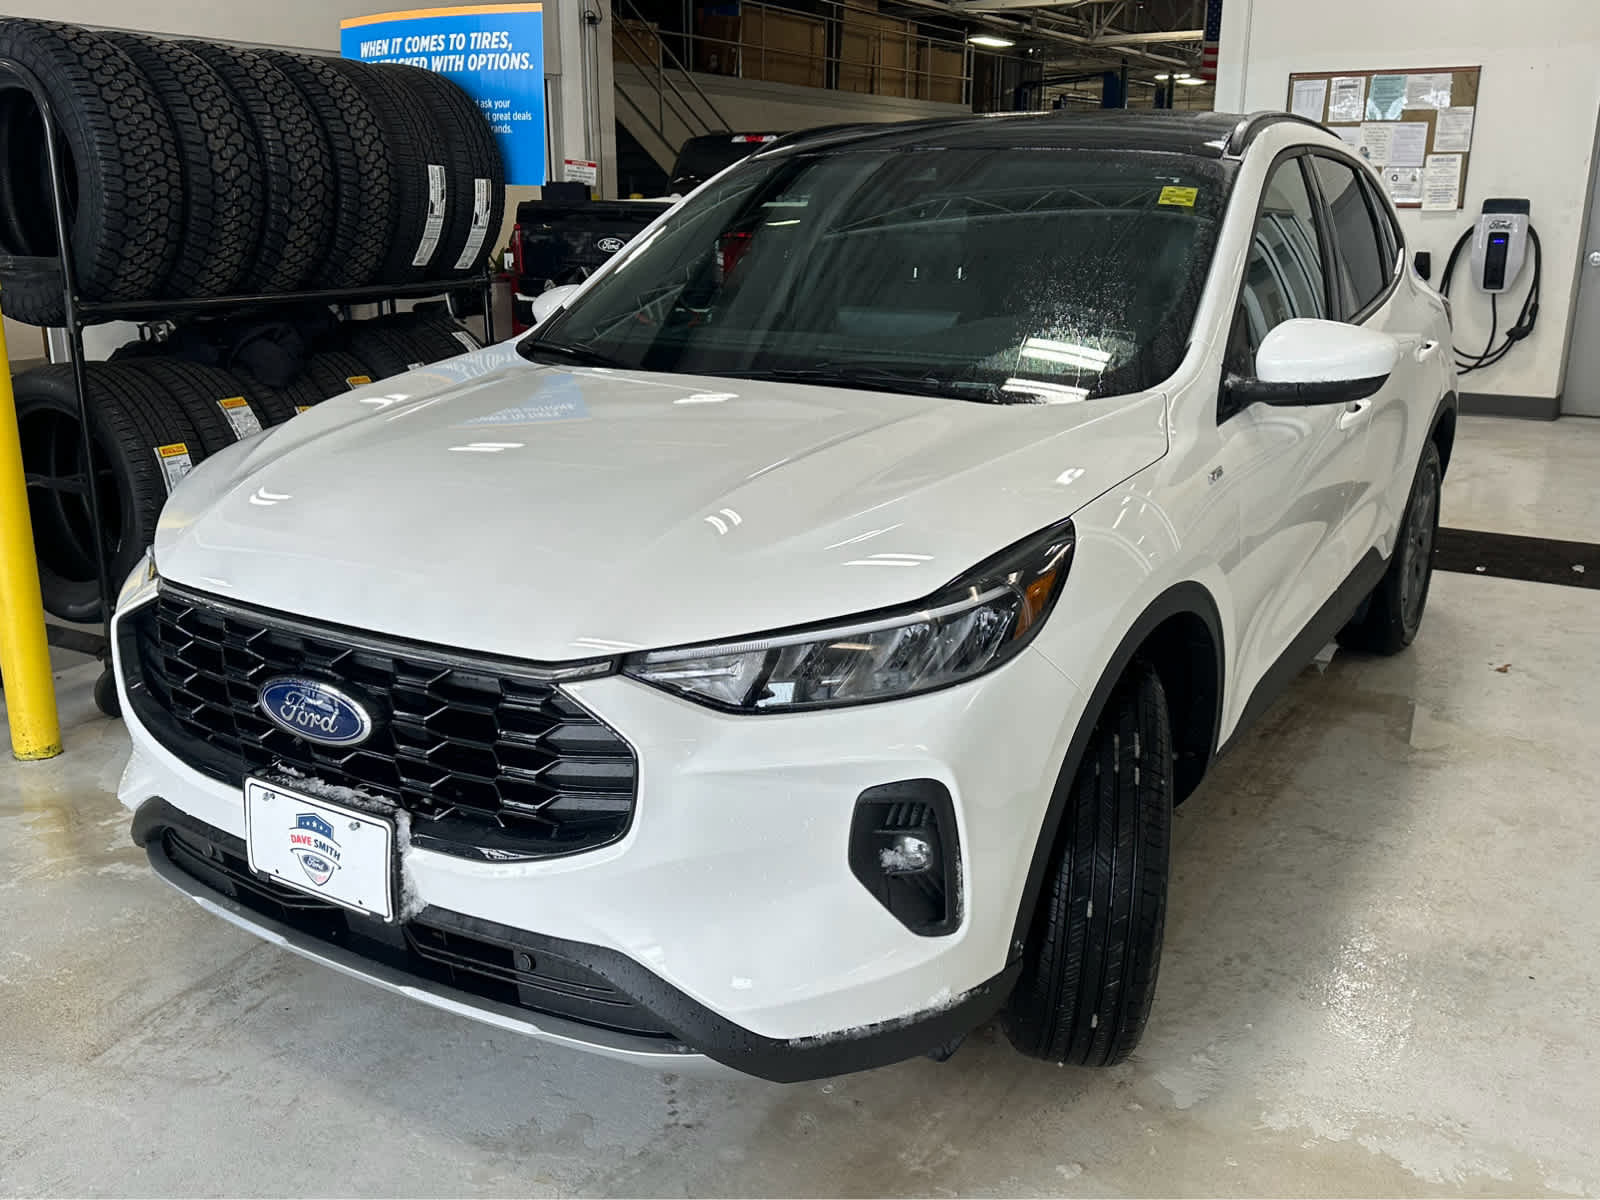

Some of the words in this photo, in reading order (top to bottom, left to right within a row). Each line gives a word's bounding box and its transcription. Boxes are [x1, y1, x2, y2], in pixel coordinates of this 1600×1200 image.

[360, 39, 388, 58] WHEN
[391, 37, 403, 54] IT
[404, 34, 446, 54] COMES
[449, 33, 466, 51] TO
[469, 31, 513, 51] TIRES,
[431, 54, 465, 72] WITH
[467, 52, 535, 71] OPTIONS.
[480, 99, 493, 108] ask
[494, 100, 511, 110] your
[492, 111, 511, 123] great
[513, 110, 532, 121] deals
[491, 123, 513, 134] rands.
[1489, 220, 1512, 229] Ford
[602, 240, 621, 250] Ford
[280, 690, 340, 733] Ford
[290, 834, 312, 847] DAVE
[313, 838, 341, 861] SMITH
